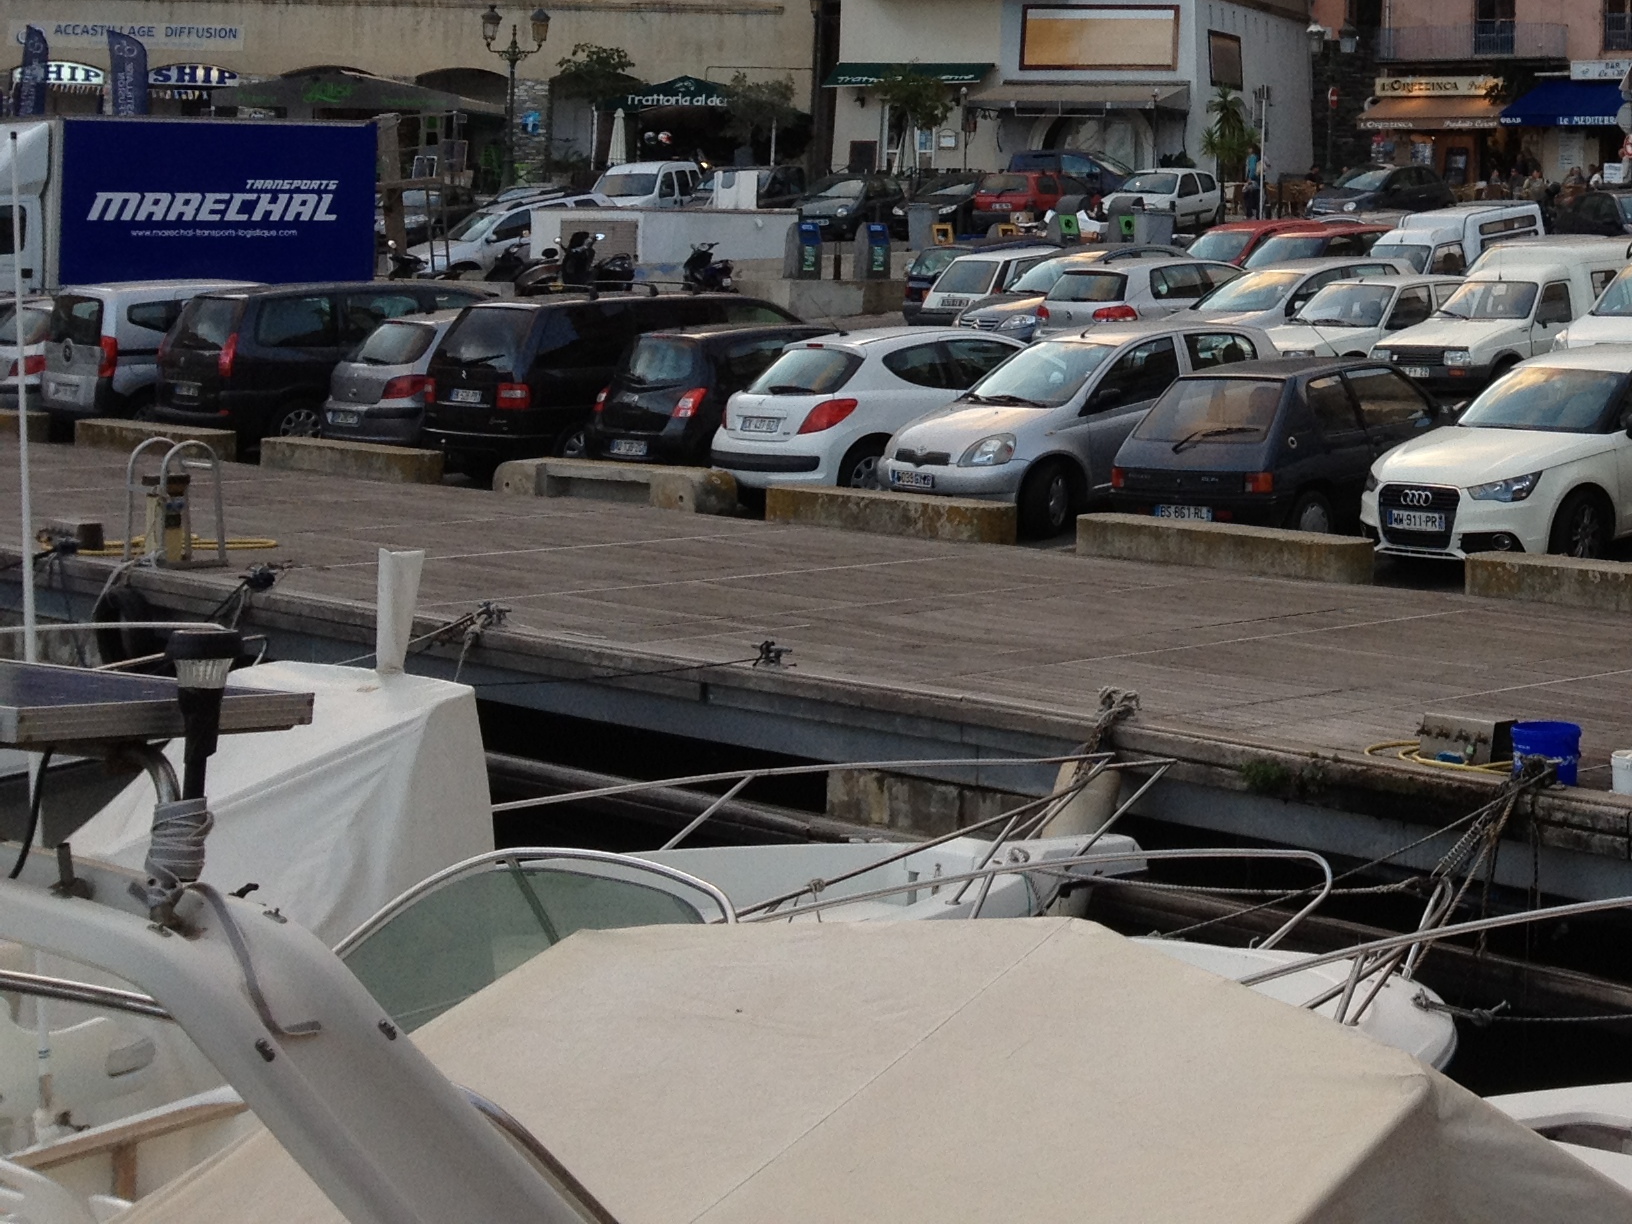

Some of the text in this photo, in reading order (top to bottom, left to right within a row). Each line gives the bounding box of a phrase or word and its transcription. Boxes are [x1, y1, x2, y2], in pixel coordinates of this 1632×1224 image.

[153, 65, 238, 85] SHIP
[627, 93, 690, 105] Trattoria
[693, 94, 705, 105] al
[1560, 116, 1568, 124] Le
[246, 180, 339, 190] TRANSPORTS
[87, 192, 337, 221] MARECHAL
[130, 229, 298, 237] www.marechal-transports-logistique.com
[1391, 512, 1438, 528] WW-911-PR
